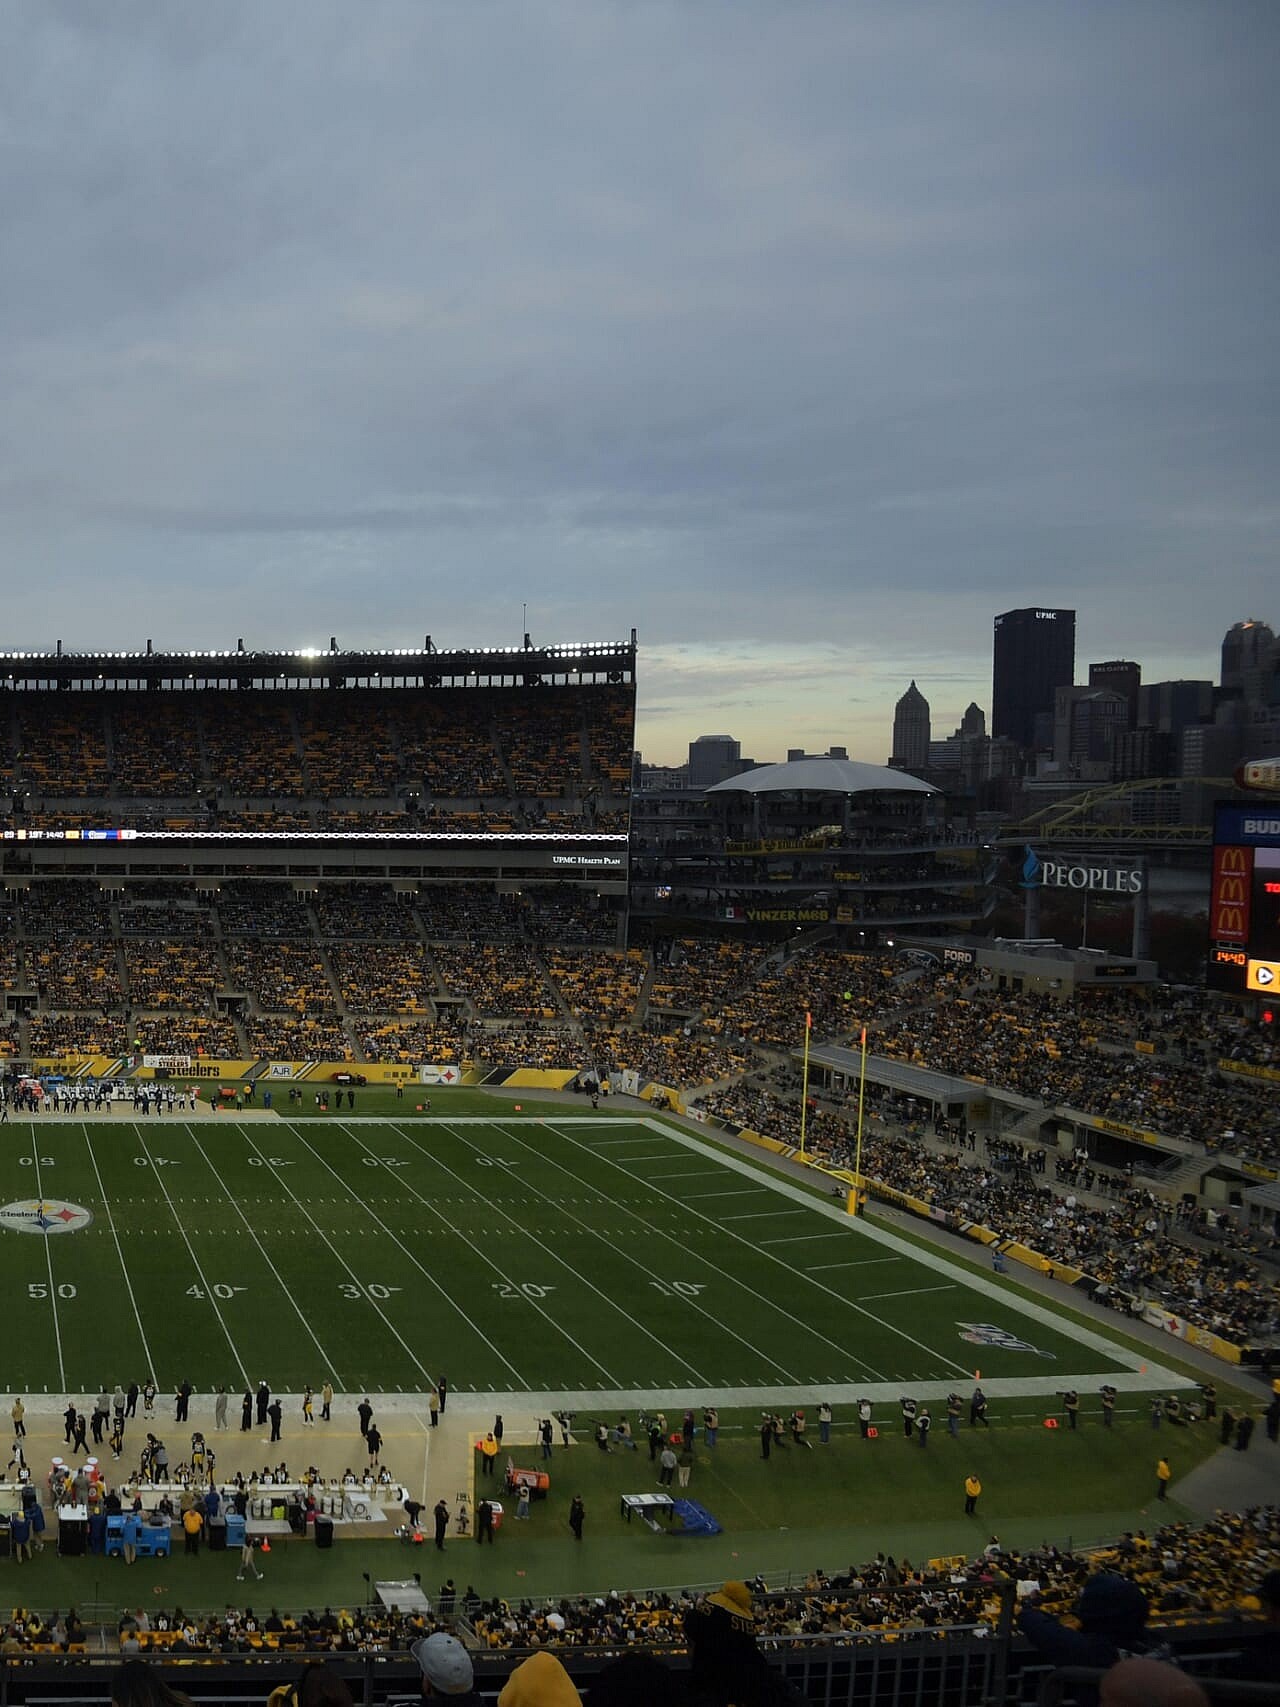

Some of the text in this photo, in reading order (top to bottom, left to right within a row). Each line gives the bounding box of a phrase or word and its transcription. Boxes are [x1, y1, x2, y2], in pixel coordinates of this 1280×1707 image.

[746, 909, 797, 921] YINZER
[944, 949, 972, 963] FORD
[1217, 951, 1246, 965] 14:40
[272, 1064, 291, 1076] AJR
[19, 1157, 55, 1166] 50
[28, 1284, 77, 1299] 50
[186, 1284, 234, 1299] 40
[339, 1284, 392, 1299] 30
[492, 1284, 546, 1298] 20
[649, 1281, 699, 1296] 10
